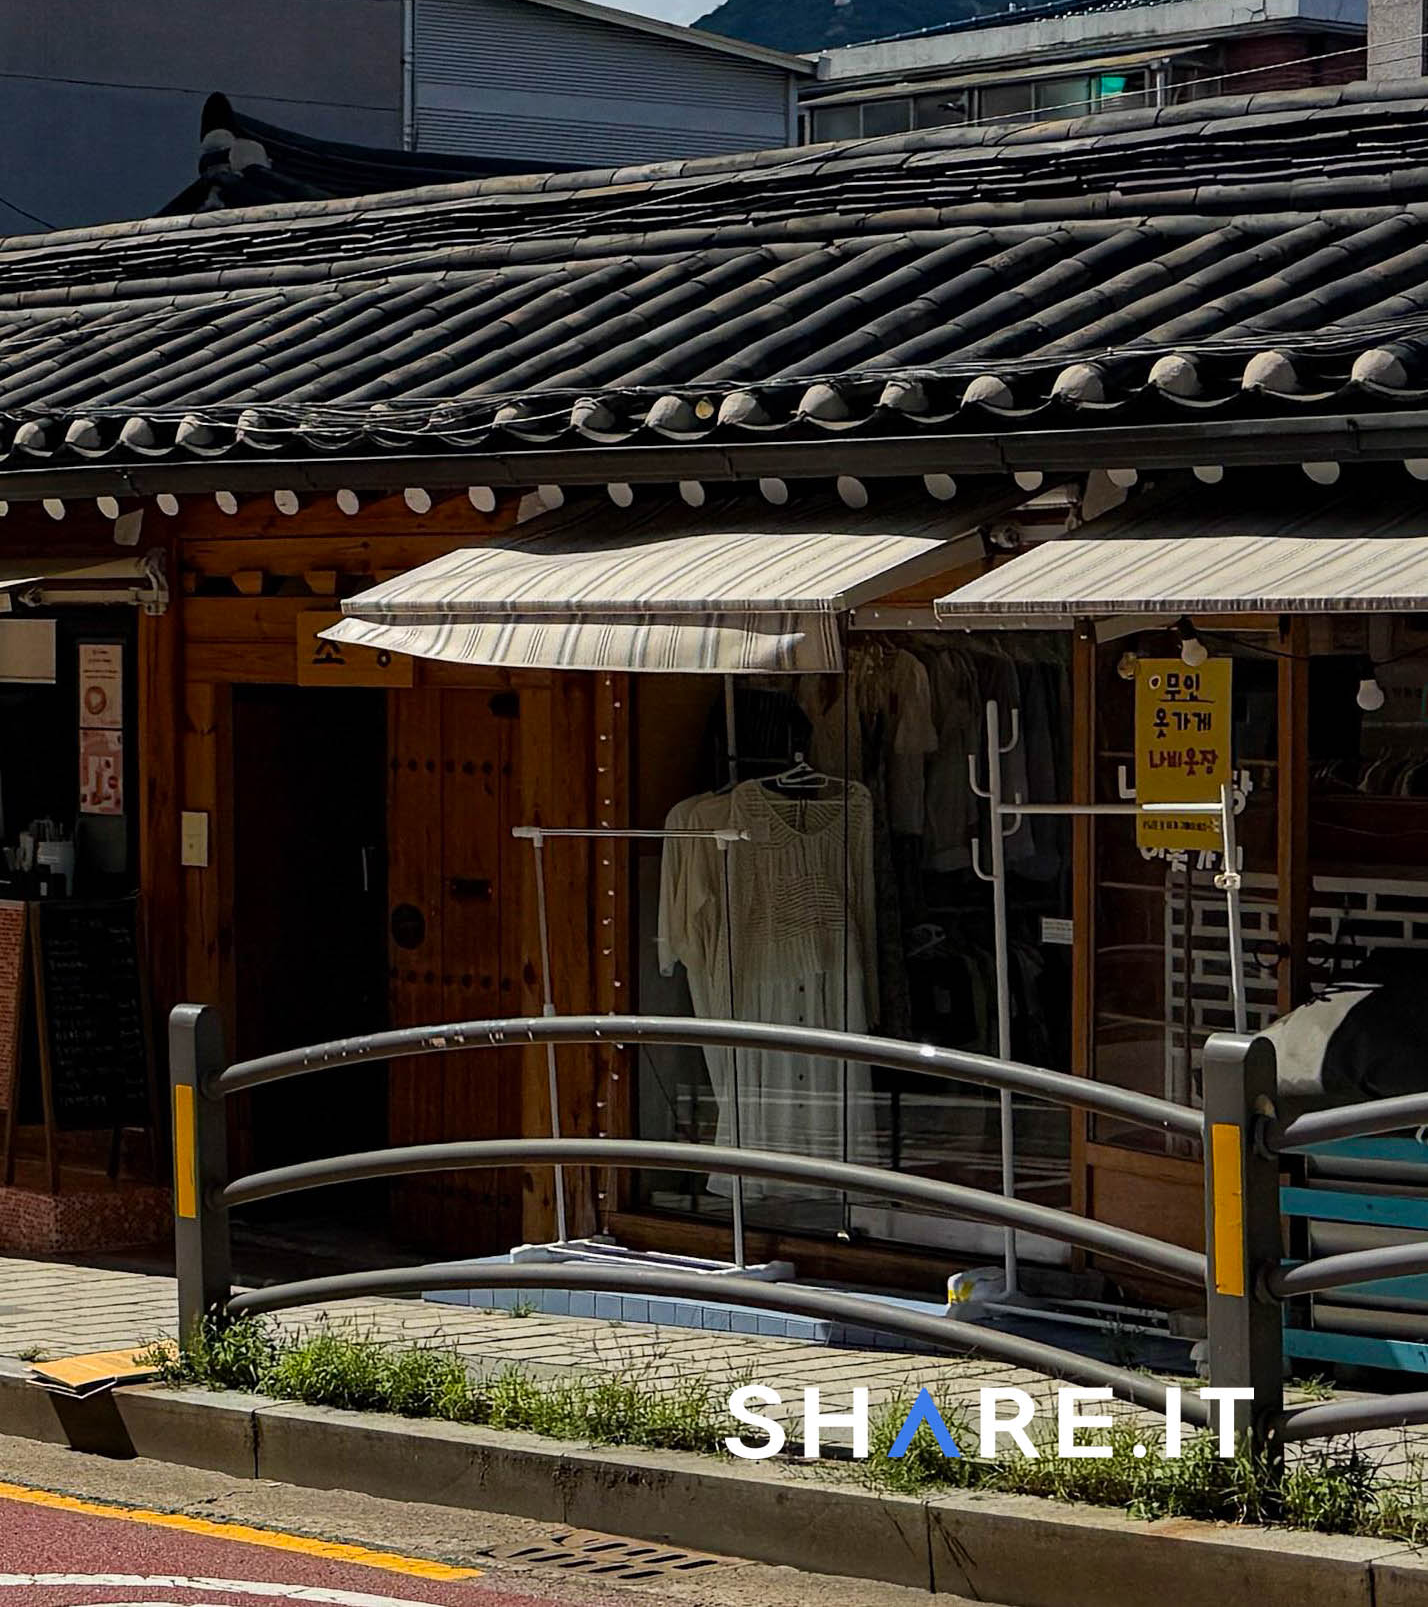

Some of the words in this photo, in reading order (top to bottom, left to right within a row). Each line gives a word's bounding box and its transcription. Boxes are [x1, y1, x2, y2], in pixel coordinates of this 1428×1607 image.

[1165, 673, 1201, 701] 무인
[1153, 707, 1212, 738] 옷가게
[1148, 747, 1218, 776] 나비옷장
